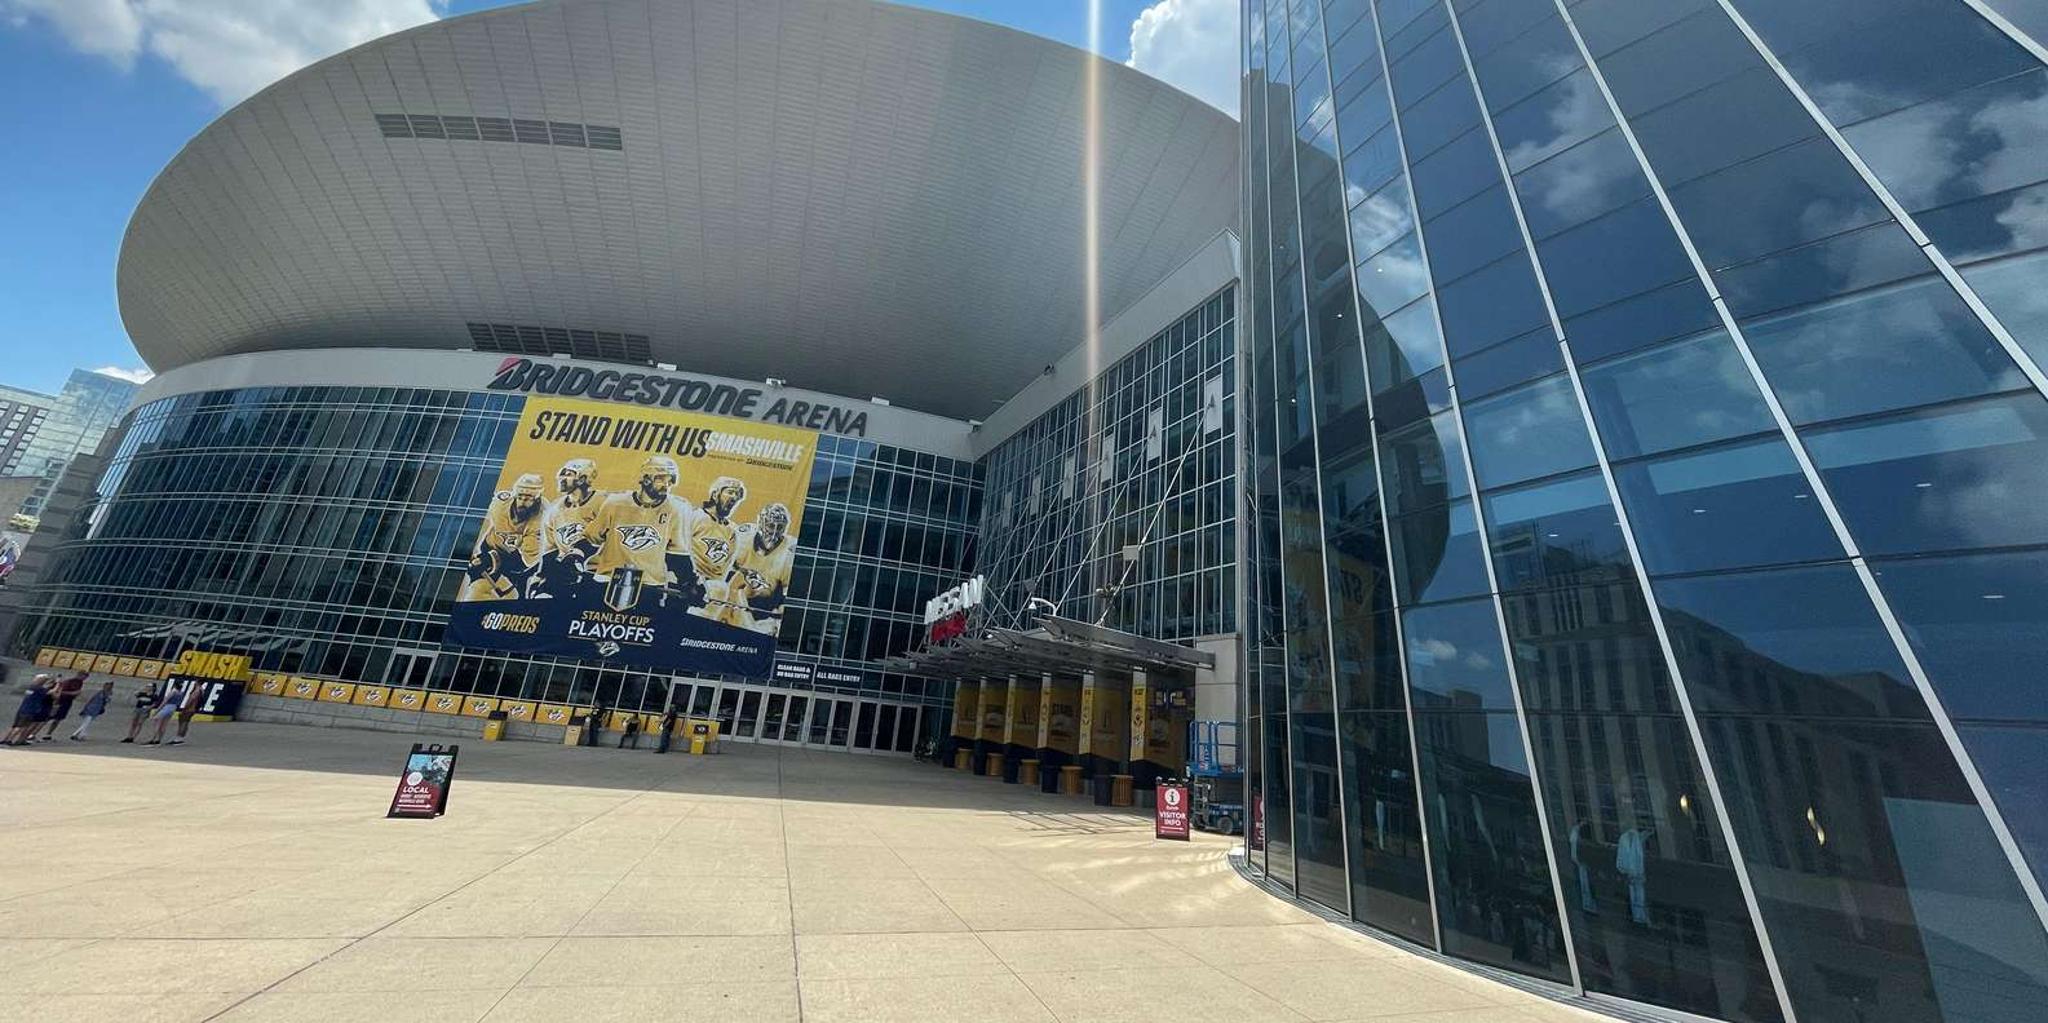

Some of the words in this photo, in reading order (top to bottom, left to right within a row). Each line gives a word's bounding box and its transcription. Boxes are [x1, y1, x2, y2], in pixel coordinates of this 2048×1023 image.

[487, 357, 763, 418] BRIDGESTONE
[762, 397, 869, 437] ARENA
[529, 410, 613, 445] STAND
[610, 417, 680, 453] WITH
[676, 427, 713, 458] US
[706, 431, 804, 462] SMASHVILLE
[481, 612, 540, 634] #GOPREDS
[581, 610, 629, 624] STANLEY
[628, 616, 651, 626] CUP
[568, 620, 655, 644] PLAYOFFS
[680, 637, 736, 652] BRIDGESTONE
[735, 645, 758, 655] ARENA
[170, 650, 244, 680] SMASH
[816, 671, 828, 679] ALL
[842, 674, 861, 682] ENTRY
[1158, 810, 1186, 820] VISITOR
